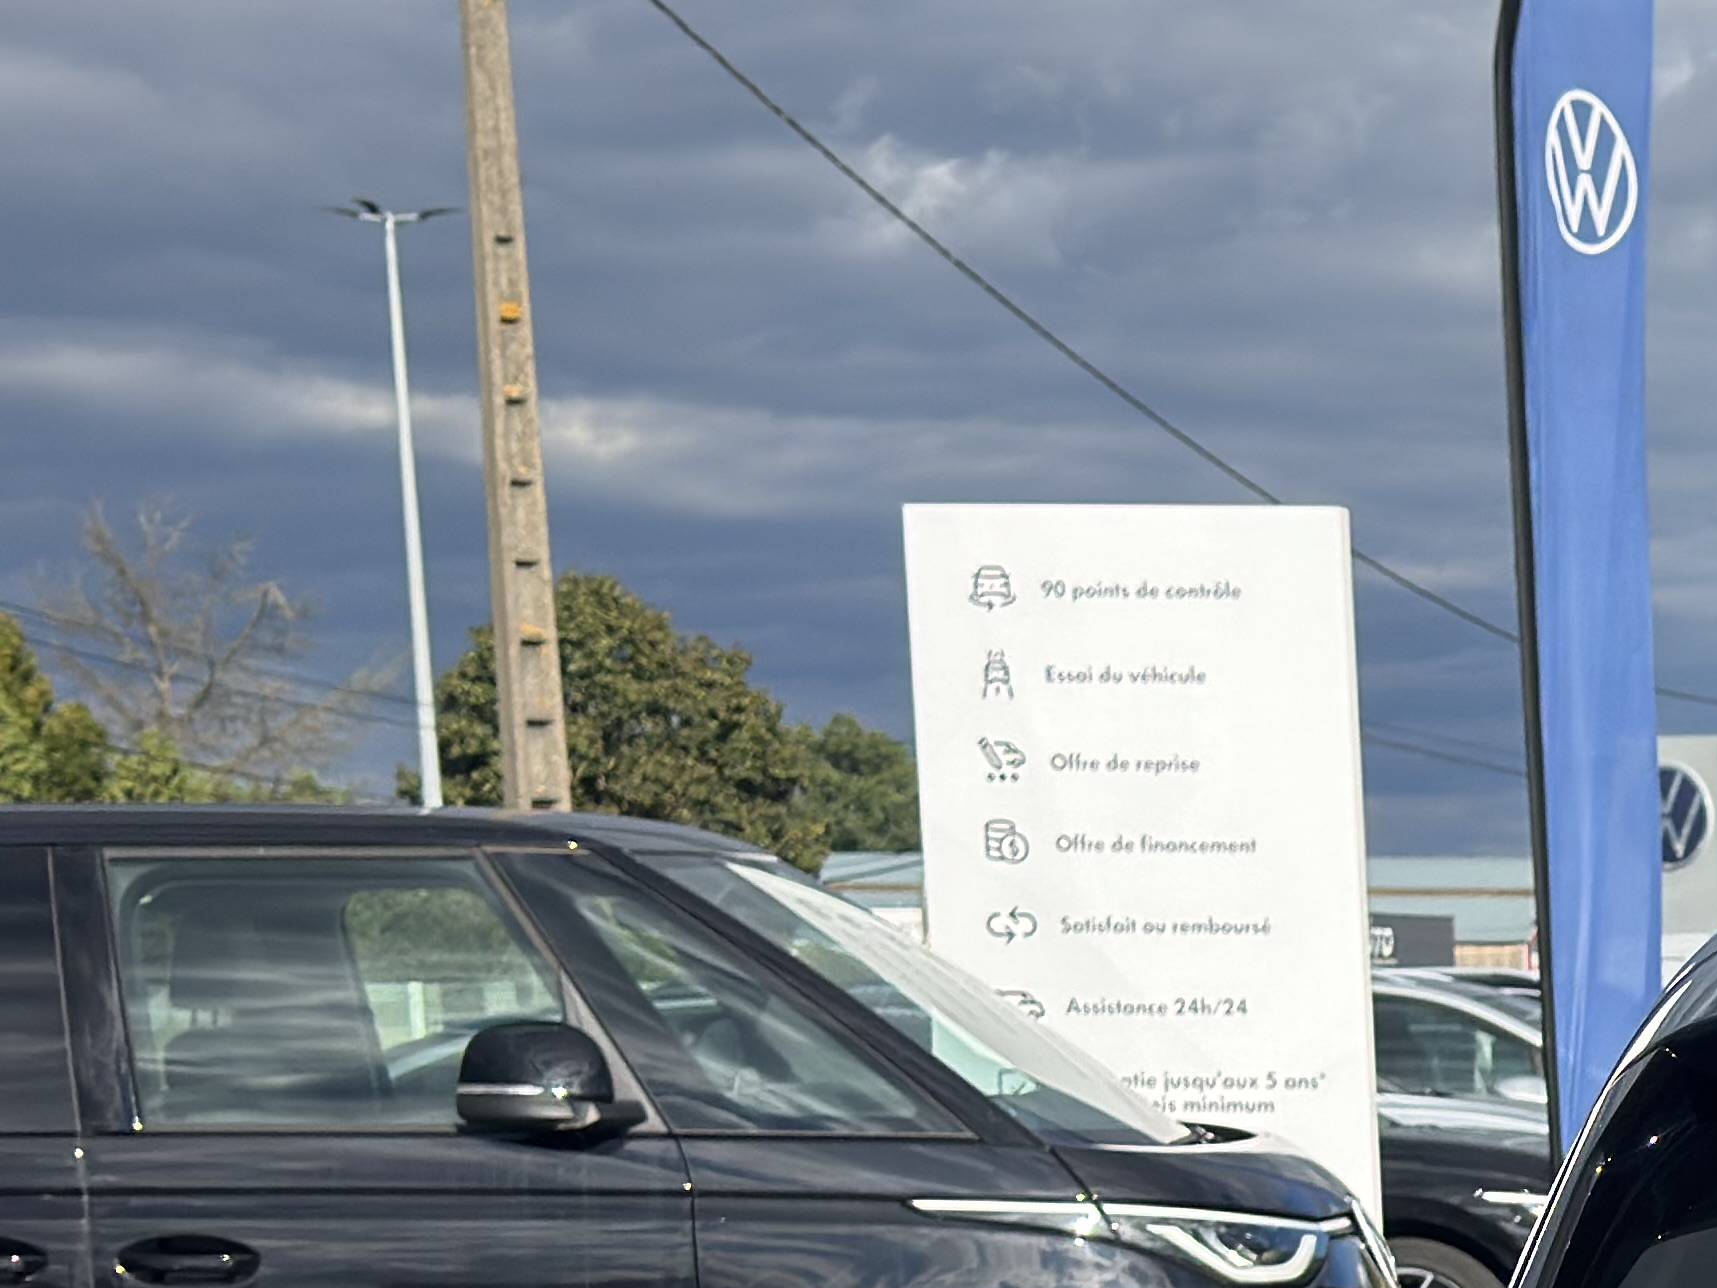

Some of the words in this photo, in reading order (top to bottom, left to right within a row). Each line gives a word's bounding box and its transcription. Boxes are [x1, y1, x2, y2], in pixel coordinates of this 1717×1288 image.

[1040, 579, 1066, 599] 90
[1072, 580, 1130, 602] points
[1135, 580, 1159, 600] de
[1165, 580, 1242, 600] contrôle
[1045, 664, 1093, 684] Essai
[1099, 664, 1124, 684] du
[1129, 665, 1206, 685] véhicule
[1050, 752, 1100, 772] Offre
[1106, 753, 1130, 772] de
[1135, 753, 1201, 776] reprise
[1055, 833, 1105, 853] Offre
[1111, 834, 1135, 853] de
[1140, 833, 1257, 853] financement
[1060, 915, 1138, 935] Satisfait
[1142, 920, 1166, 934] ou
[1172, 916, 1272, 935] remboursé
[1065, 997, 1168, 1016] Assistance
[1174, 997, 1249, 1016] 24h/24
[1265, 1072, 1278, 1090] 5
[1183, 1096, 1276, 1113] minimum
